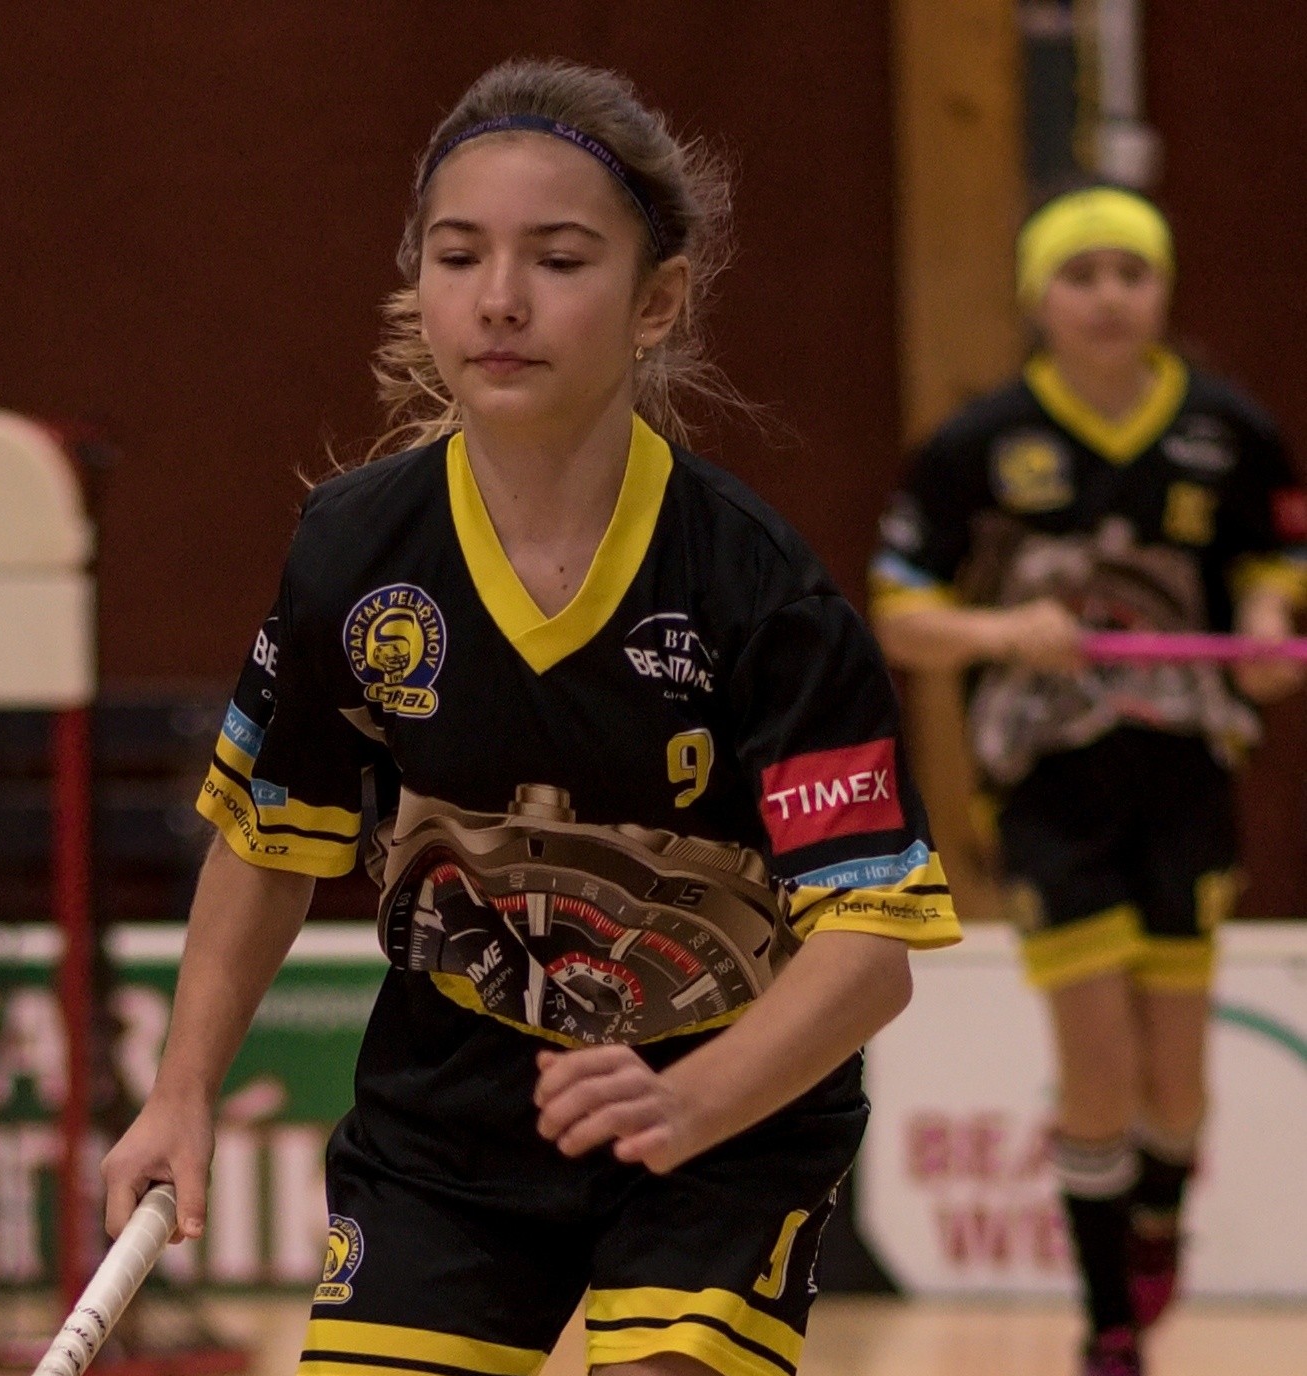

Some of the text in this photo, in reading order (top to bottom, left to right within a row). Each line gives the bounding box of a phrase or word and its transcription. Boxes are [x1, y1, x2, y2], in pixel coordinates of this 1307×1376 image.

[350, 596, 385, 671] SPARTAK
[667, 727, 714, 808] 9
[767, 769, 890, 820] TIMEX
[713, 958, 736, 976] 180
